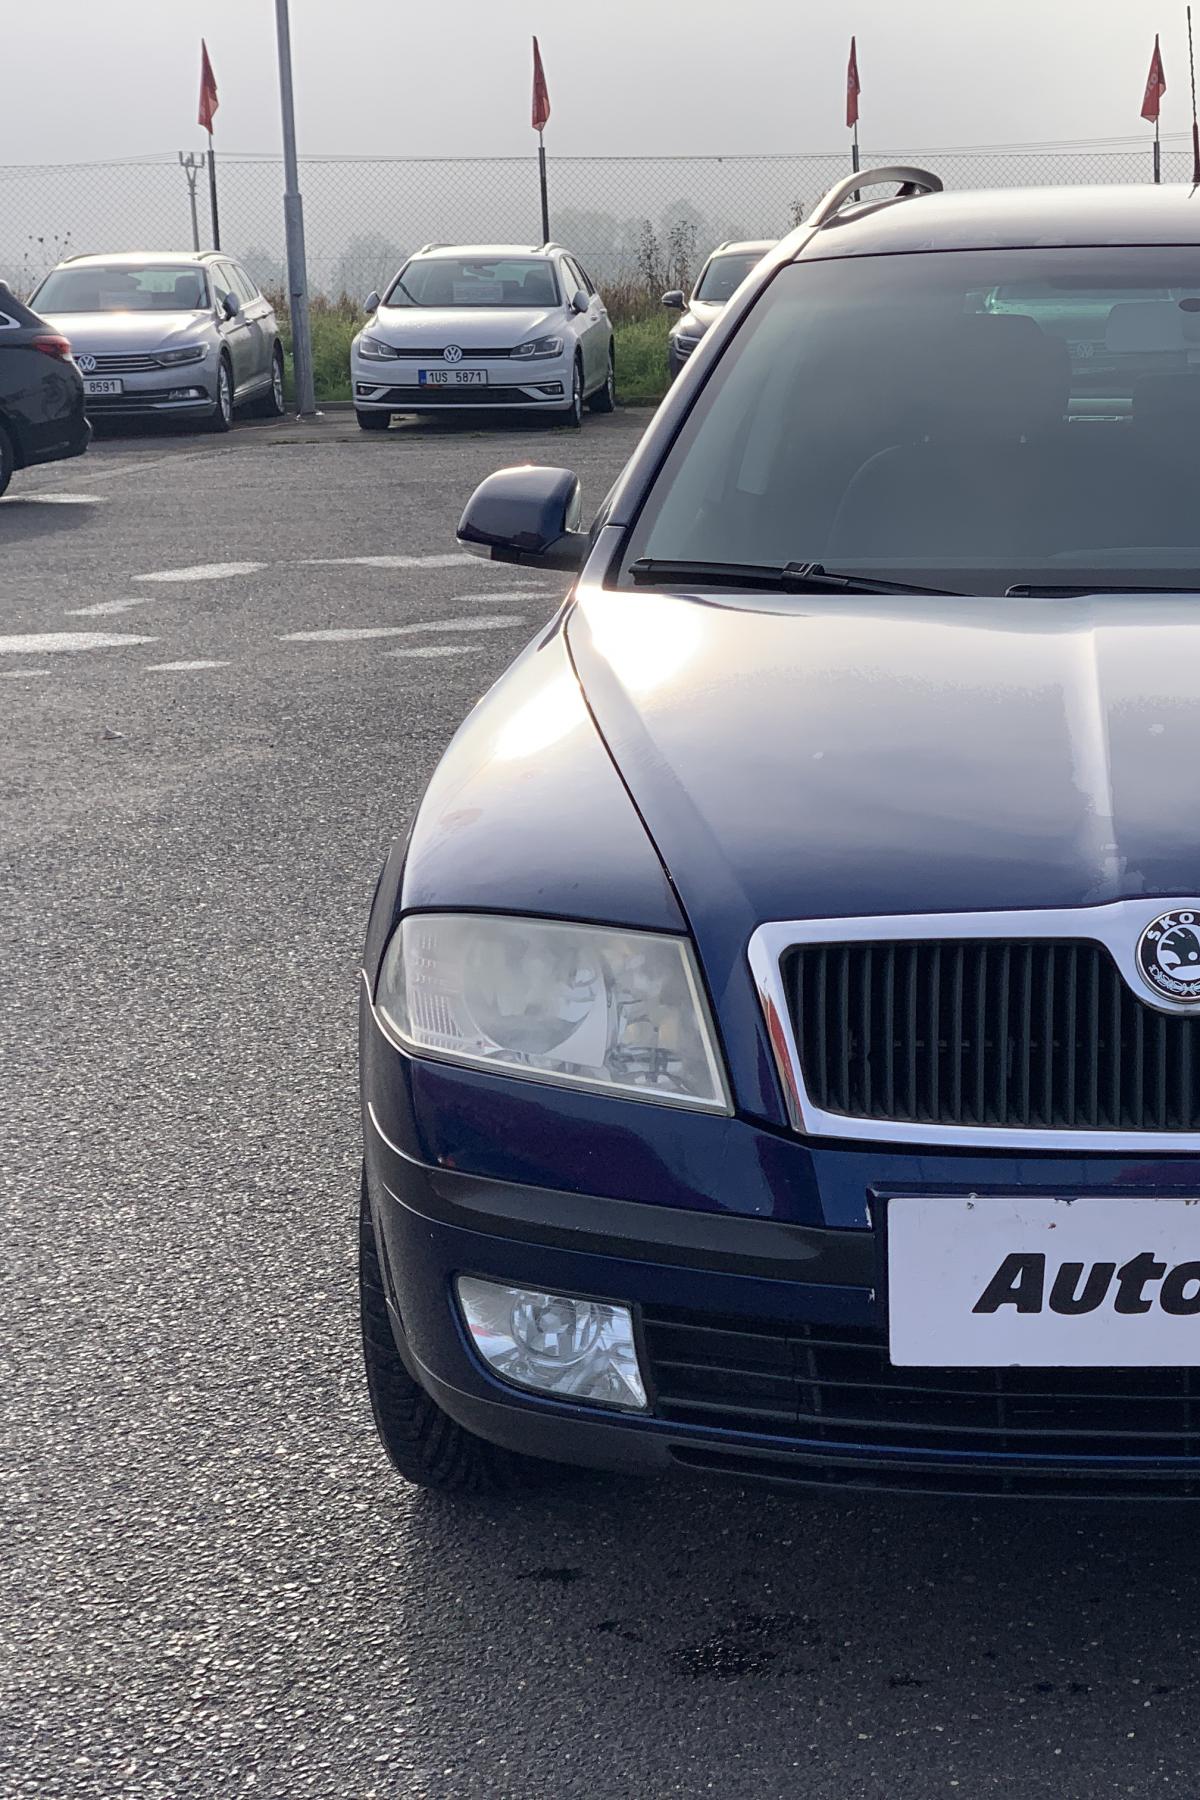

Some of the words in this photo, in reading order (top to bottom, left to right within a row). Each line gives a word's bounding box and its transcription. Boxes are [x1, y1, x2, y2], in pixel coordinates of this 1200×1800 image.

[429, 372, 448, 383] 1US
[455, 372, 482, 383] 5871
[89, 381, 116, 393] 8591
